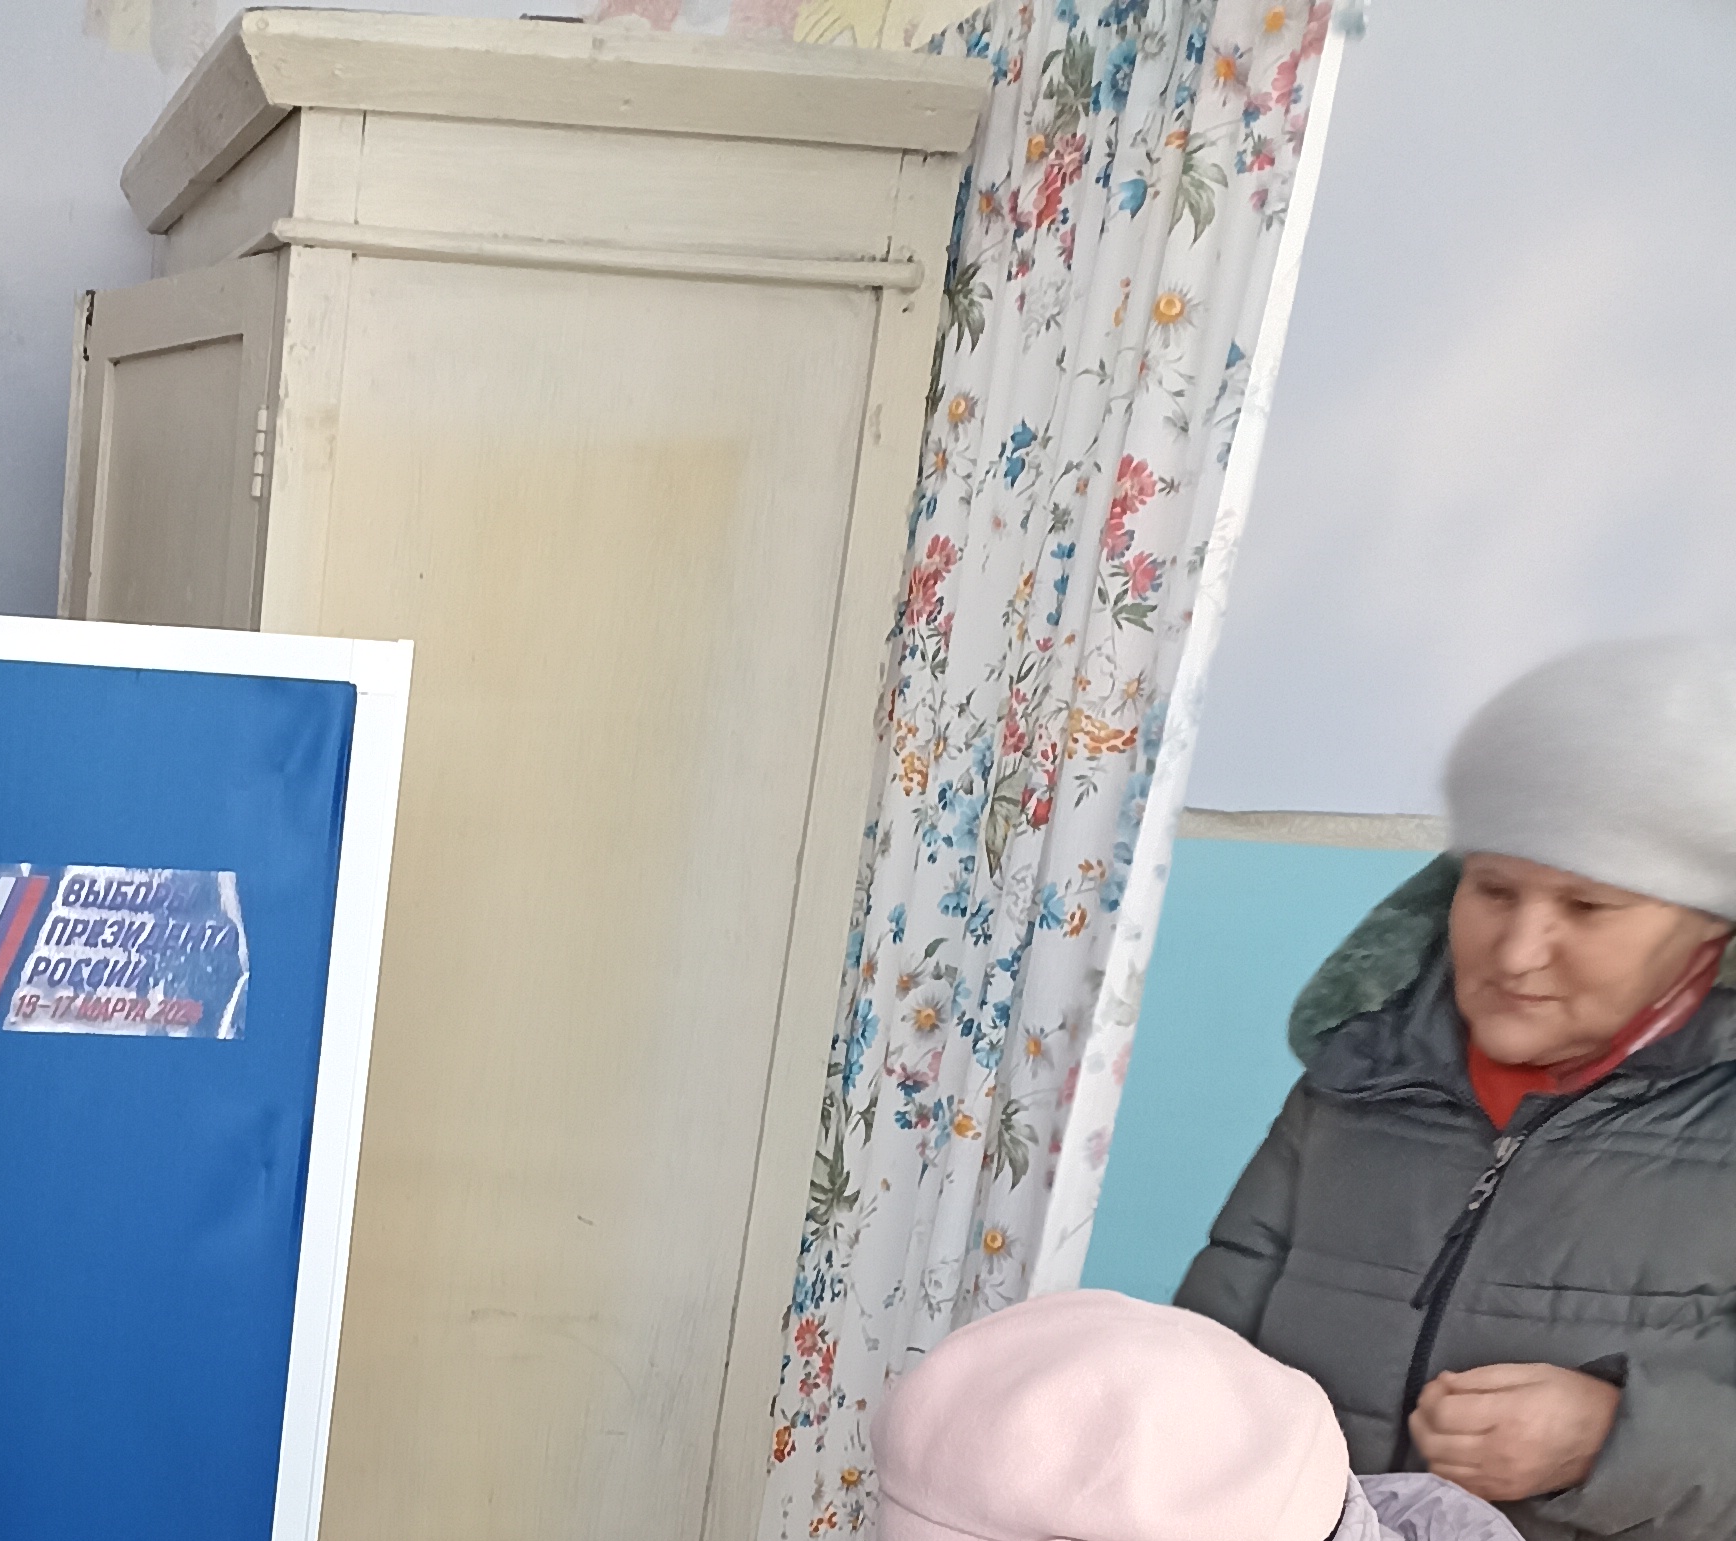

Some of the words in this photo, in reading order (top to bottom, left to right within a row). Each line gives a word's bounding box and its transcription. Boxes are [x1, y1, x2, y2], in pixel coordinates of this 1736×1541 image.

[44, 915, 240, 954] ПРЕЗИДЕНТА
[26, 955, 149, 989] РОССИИ
[75, 996, 151, 1022] МАРТА
